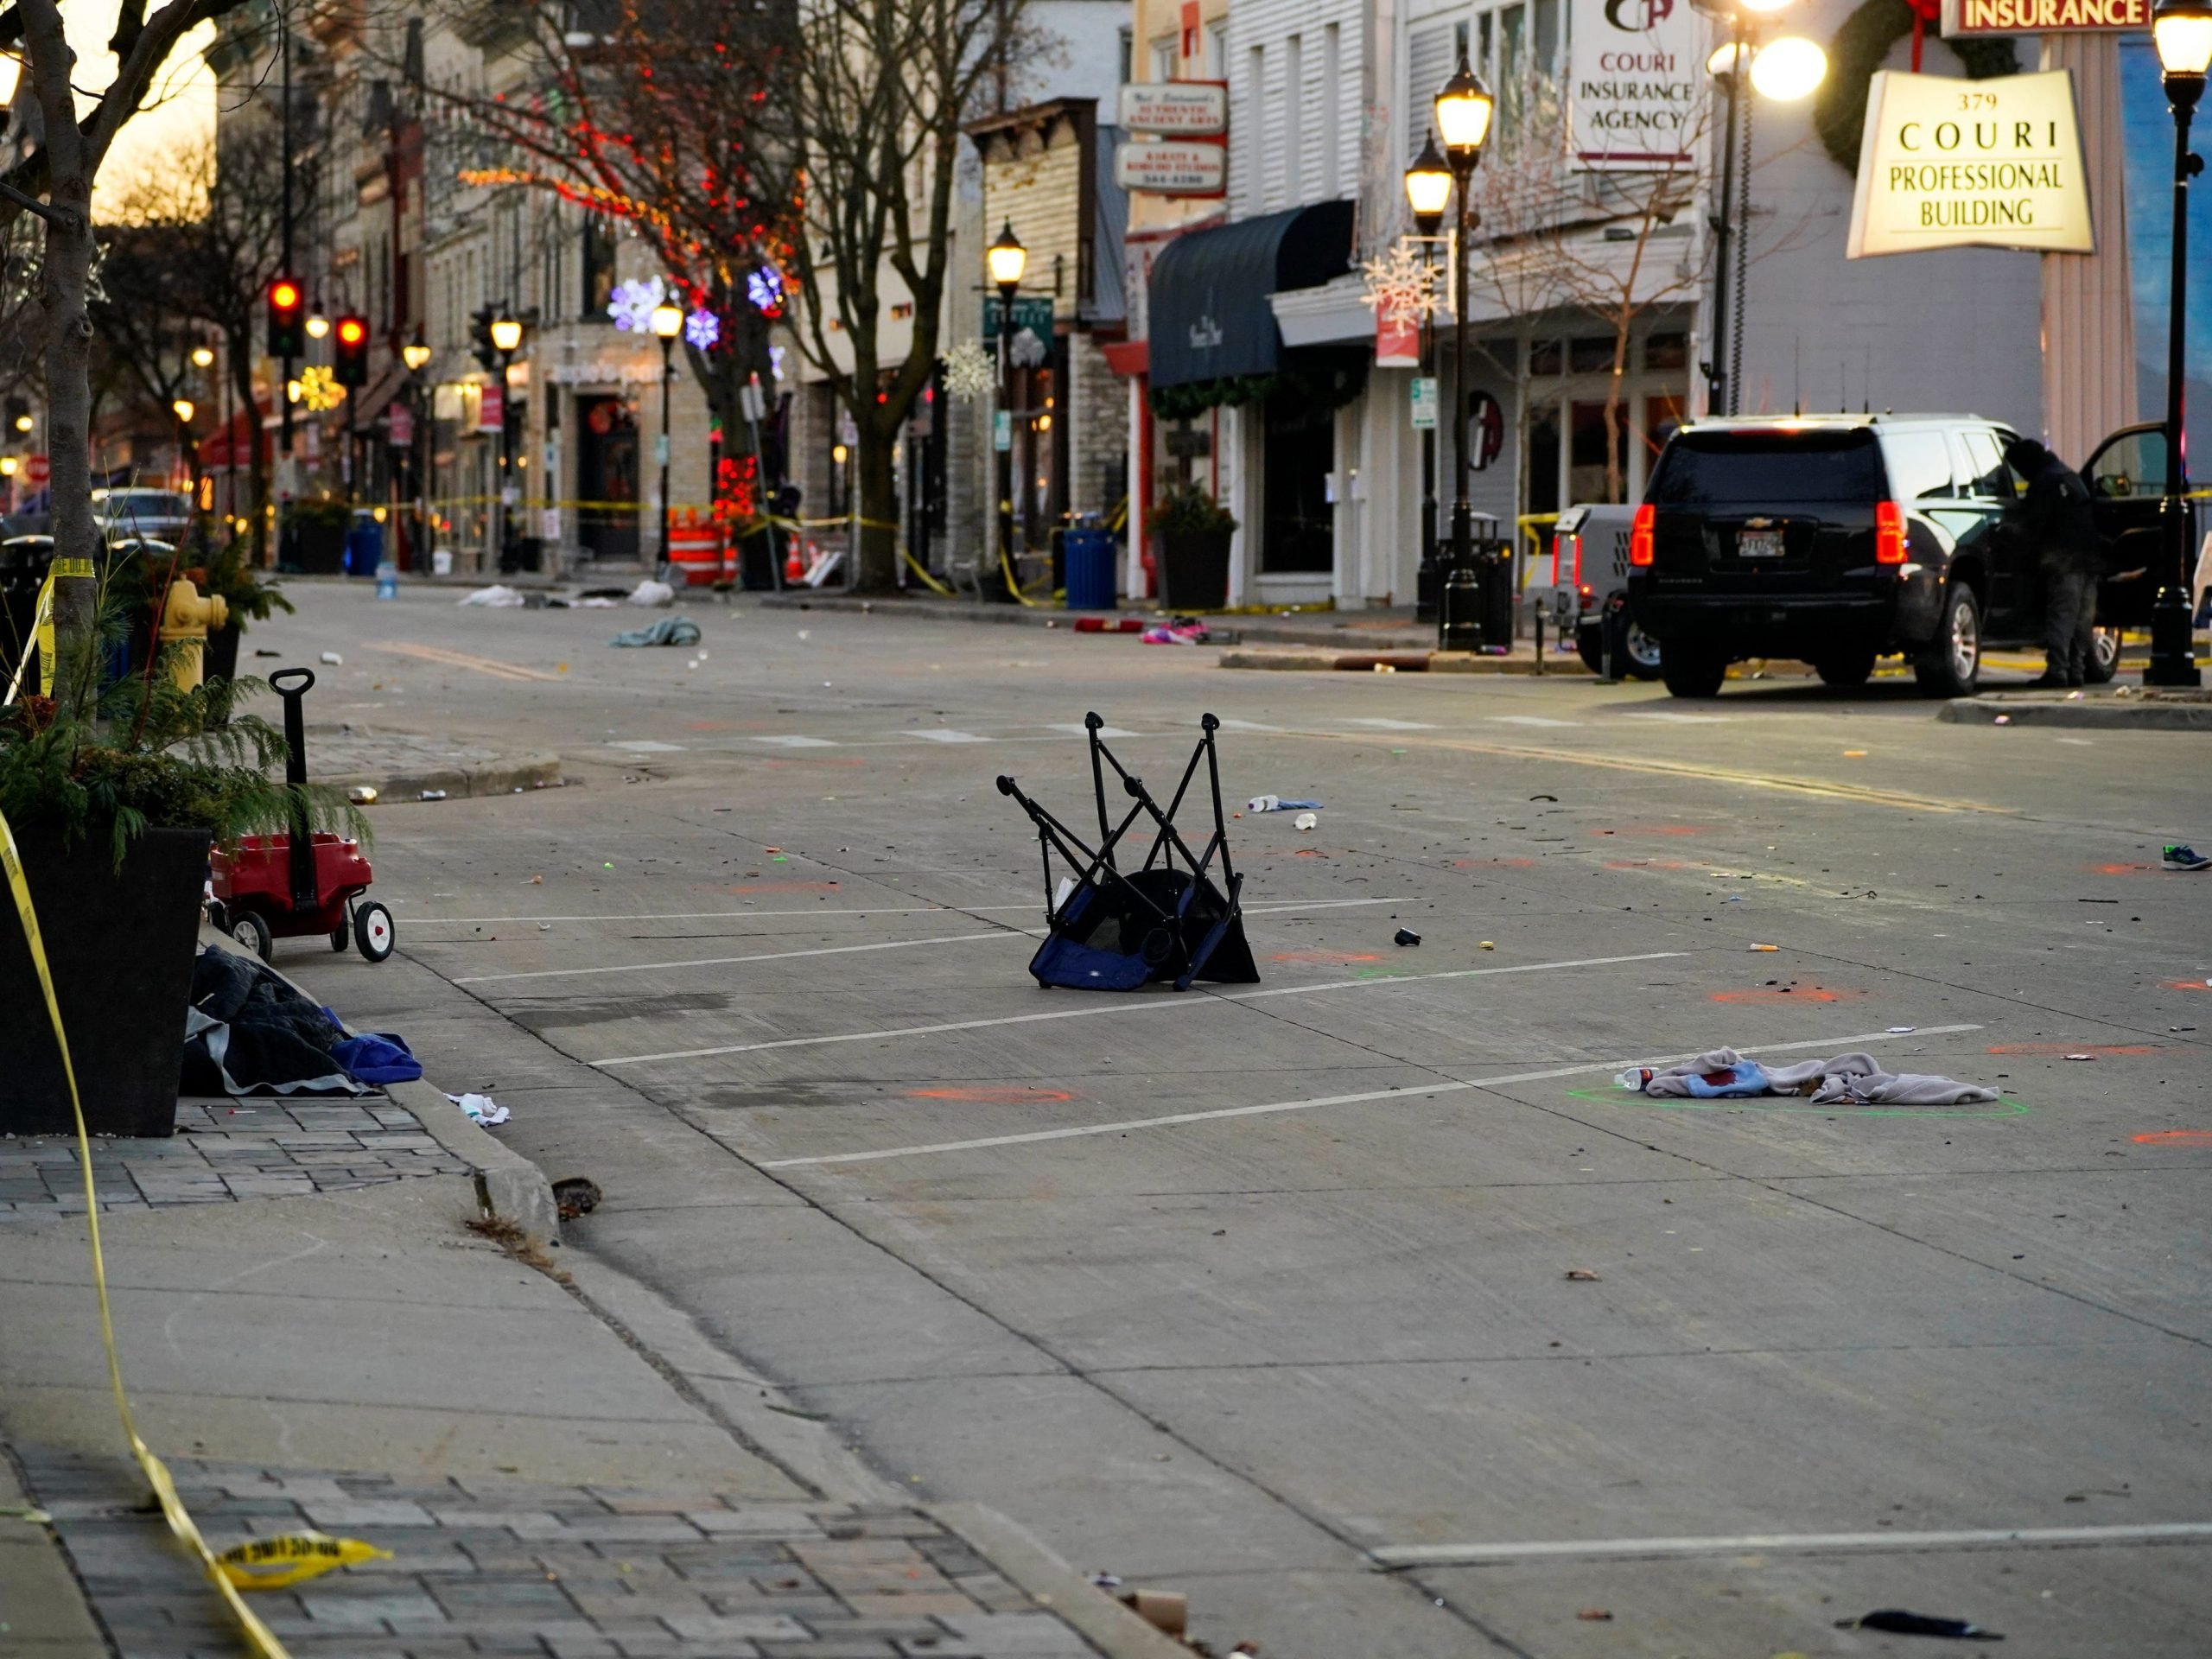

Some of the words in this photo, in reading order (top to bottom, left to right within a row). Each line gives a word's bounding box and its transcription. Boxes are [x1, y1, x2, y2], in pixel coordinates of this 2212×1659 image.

[1965, 0, 2144, 27] INSURANCE
[1600, 52, 1675, 72] COURI
[1580, 81, 1694, 101] INSURANCE
[1958, 93, 1998, 111] 379
[1590, 109, 1682, 129] AGENCY
[1899, 121, 2056, 151] COURI
[1890, 163, 2063, 192] PROFESSIONAL
[1922, 199, 2033, 226] BUILDING
